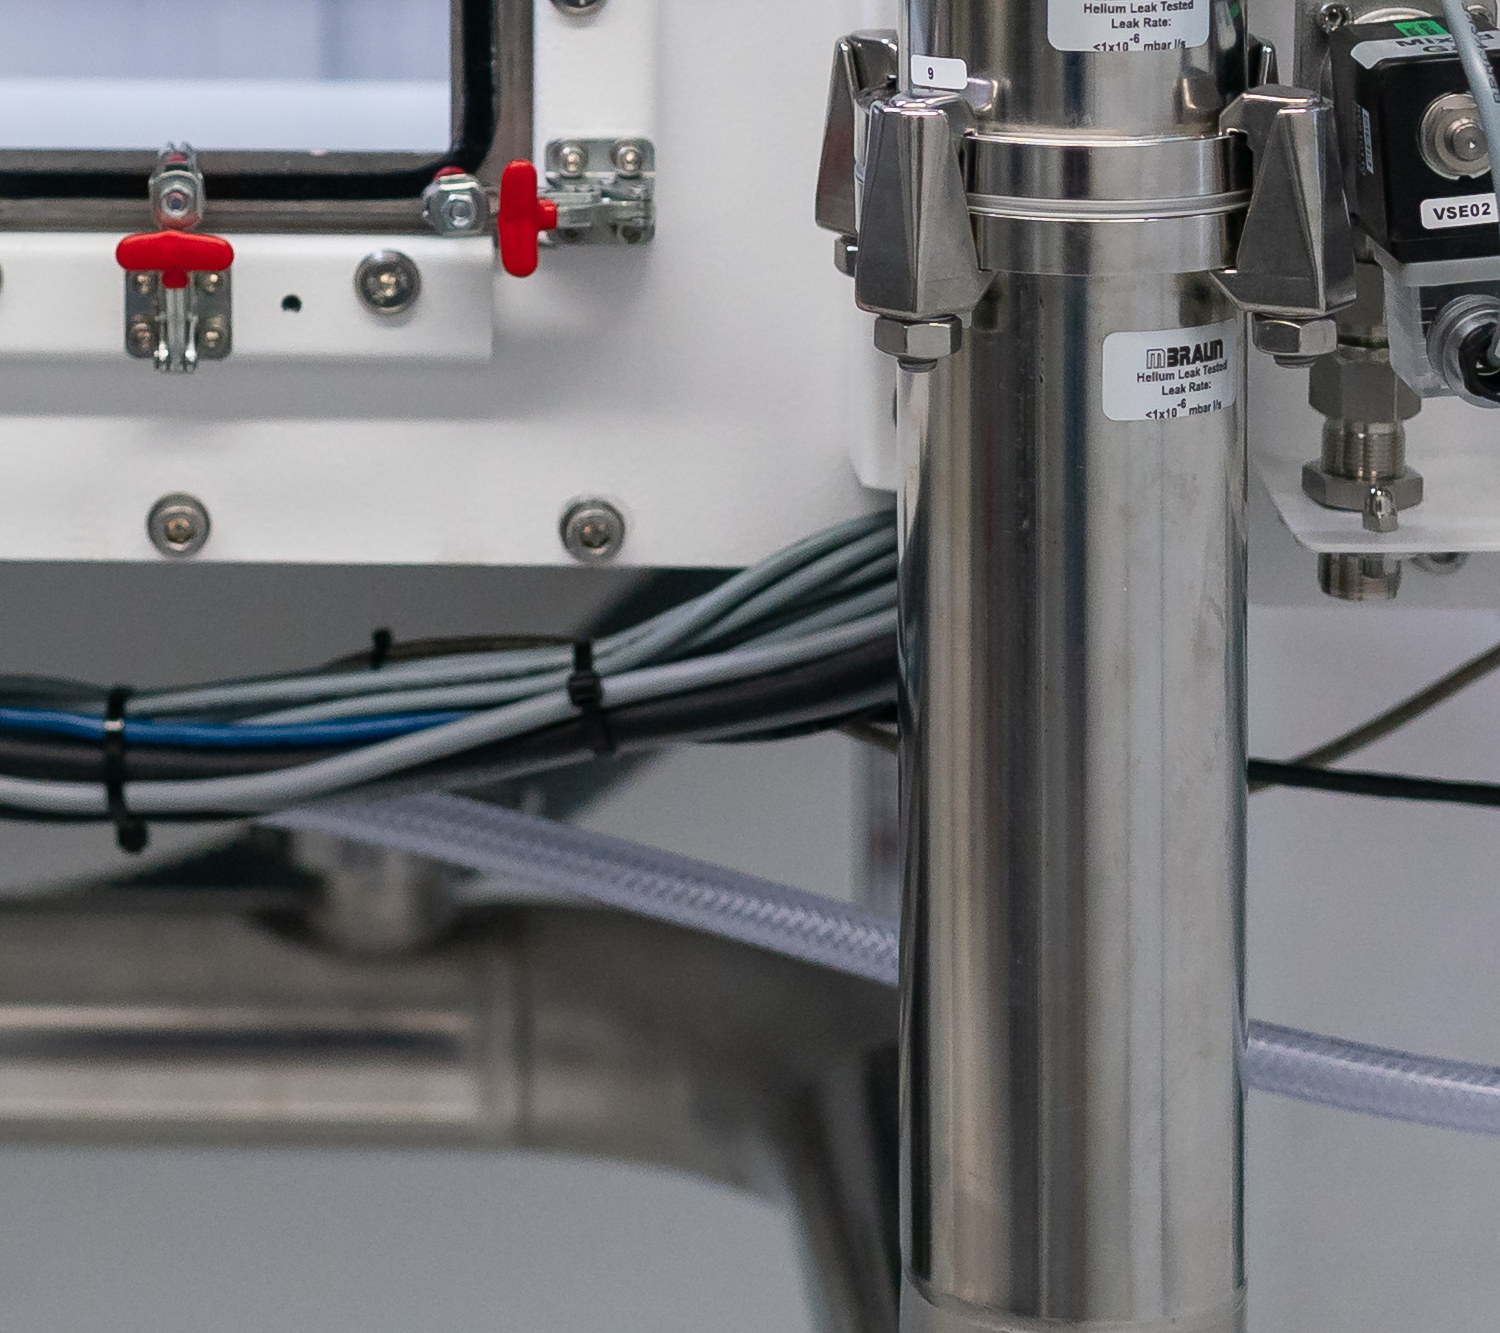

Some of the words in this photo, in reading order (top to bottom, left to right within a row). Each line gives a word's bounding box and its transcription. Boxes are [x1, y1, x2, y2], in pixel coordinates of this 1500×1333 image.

[1083, 2, 1127, 14] Helium
[1130, 1, 1157, 13] Leak
[1160, 0, 1194, 12] Tested
[1111, 18, 1139, 29] Leak
[1143, 17, 1172, 28] Rate:
[1143, 39, 1171, 51] mbar
[927, 67, 934, 80] 9
[1433, 202, 1491, 221] VSE02
[1136, 372, 1175, 383] Helium
[1178, 367, 1200, 380] Leak
[1202, 359, 1228, 376] Tested
[1162, 384, 1186, 396] Leak
[1189, 381, 1212, 393] Rate:
[1189, 403, 1211, 416] mbar
